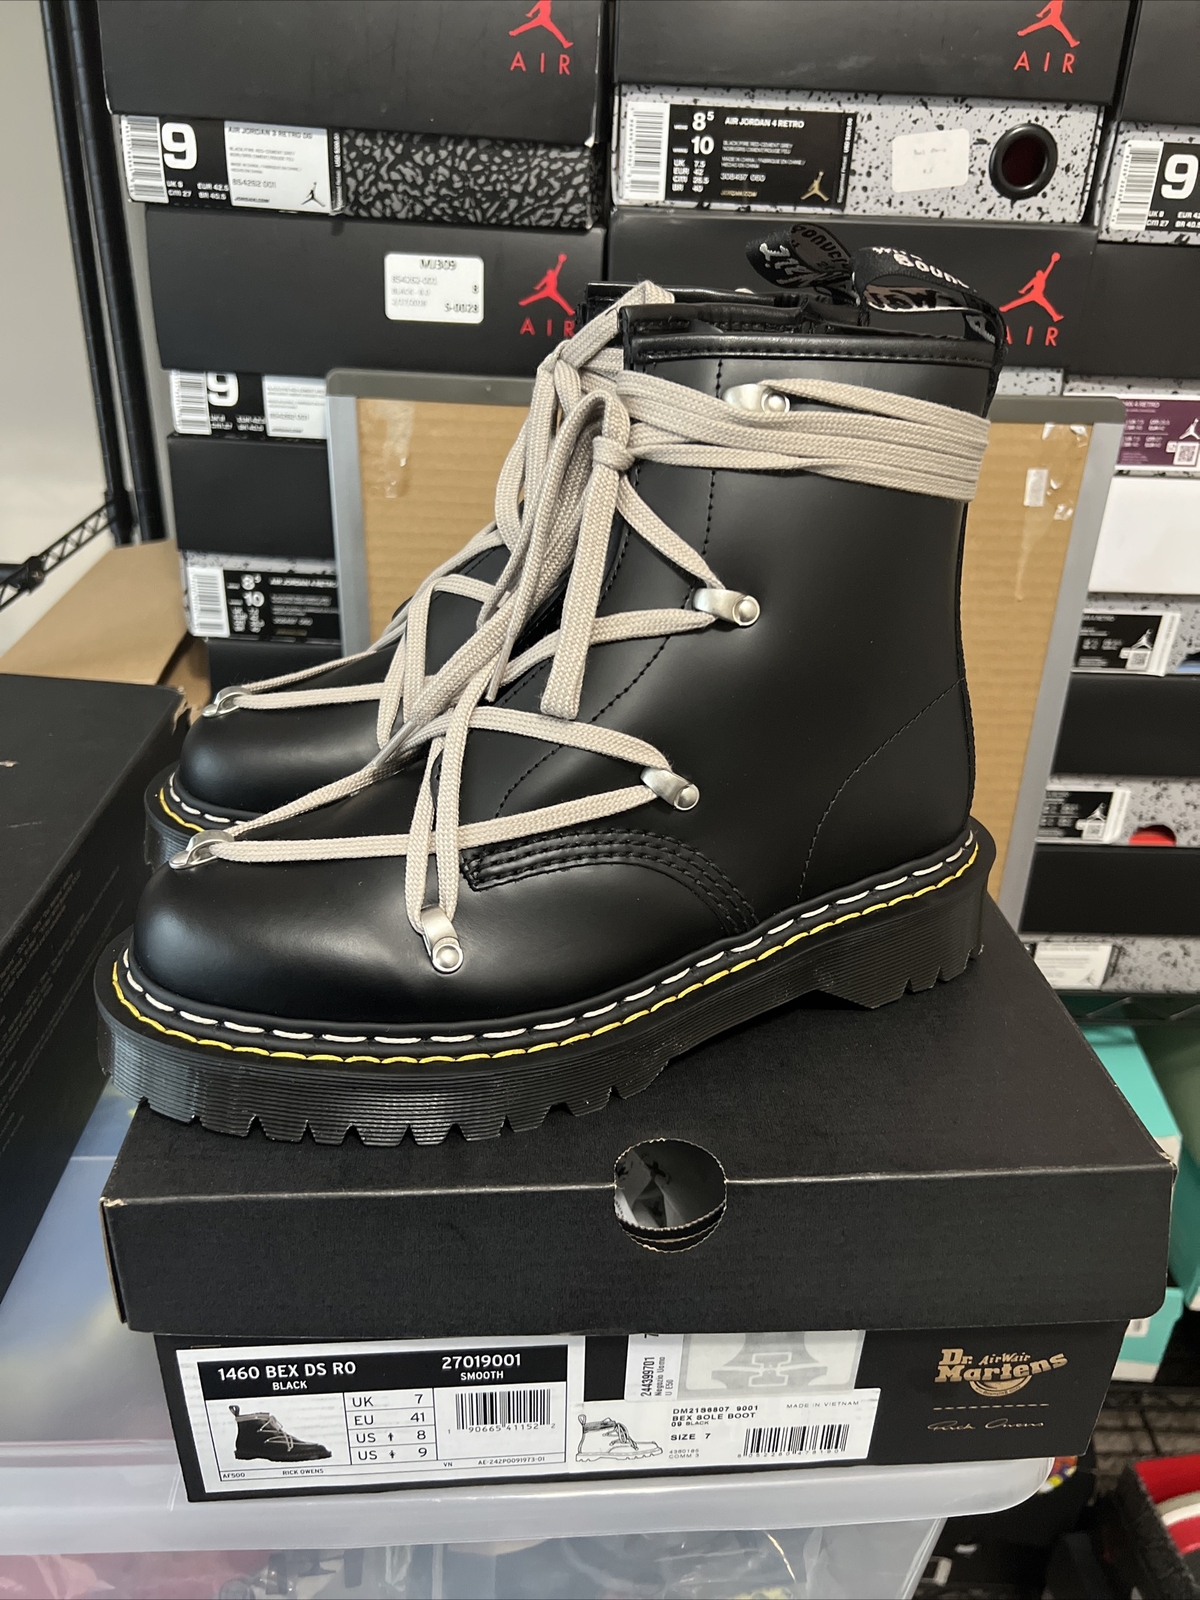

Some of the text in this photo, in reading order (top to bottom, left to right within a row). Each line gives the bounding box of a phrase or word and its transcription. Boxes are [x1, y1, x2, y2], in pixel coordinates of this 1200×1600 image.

[510, 51, 570, 75] AIR
[1014, 50, 1075, 74] AIR
[725, 117, 738, 125] AIR
[739, 117, 771, 127] JORDAN
[778, 120, 804, 128] RETRO
[162, 122, 197, 170] 9
[691, 136, 714, 155] 10
[1161, 154, 1199, 200] 9
[519, 317, 575, 337] AIR
[208, 372, 238, 406] 9
[242, 591, 264, 607] 10
[442, 1353, 521, 1370] 27019001
[939, 1348, 1031, 1365] Dr. AirWair
[218, 1361, 356, 1381] 1460 BEX DS RO
[460, 1371, 504, 1381] SMOOTH
[934, 1353, 1068, 1382] Martens
[641, 1357, 654, 1396] 244399701
[272, 1381, 307, 1391] BLACK
[352, 1394, 423, 1407] UK 7
[354, 1412, 425, 1425] EU 41
[356, 1430, 426, 1443] US 8
[469, 1425, 501, 1433] 90665
[506, 1423, 539, 1431] 41152
[358, 1447, 427, 1460] US 9
